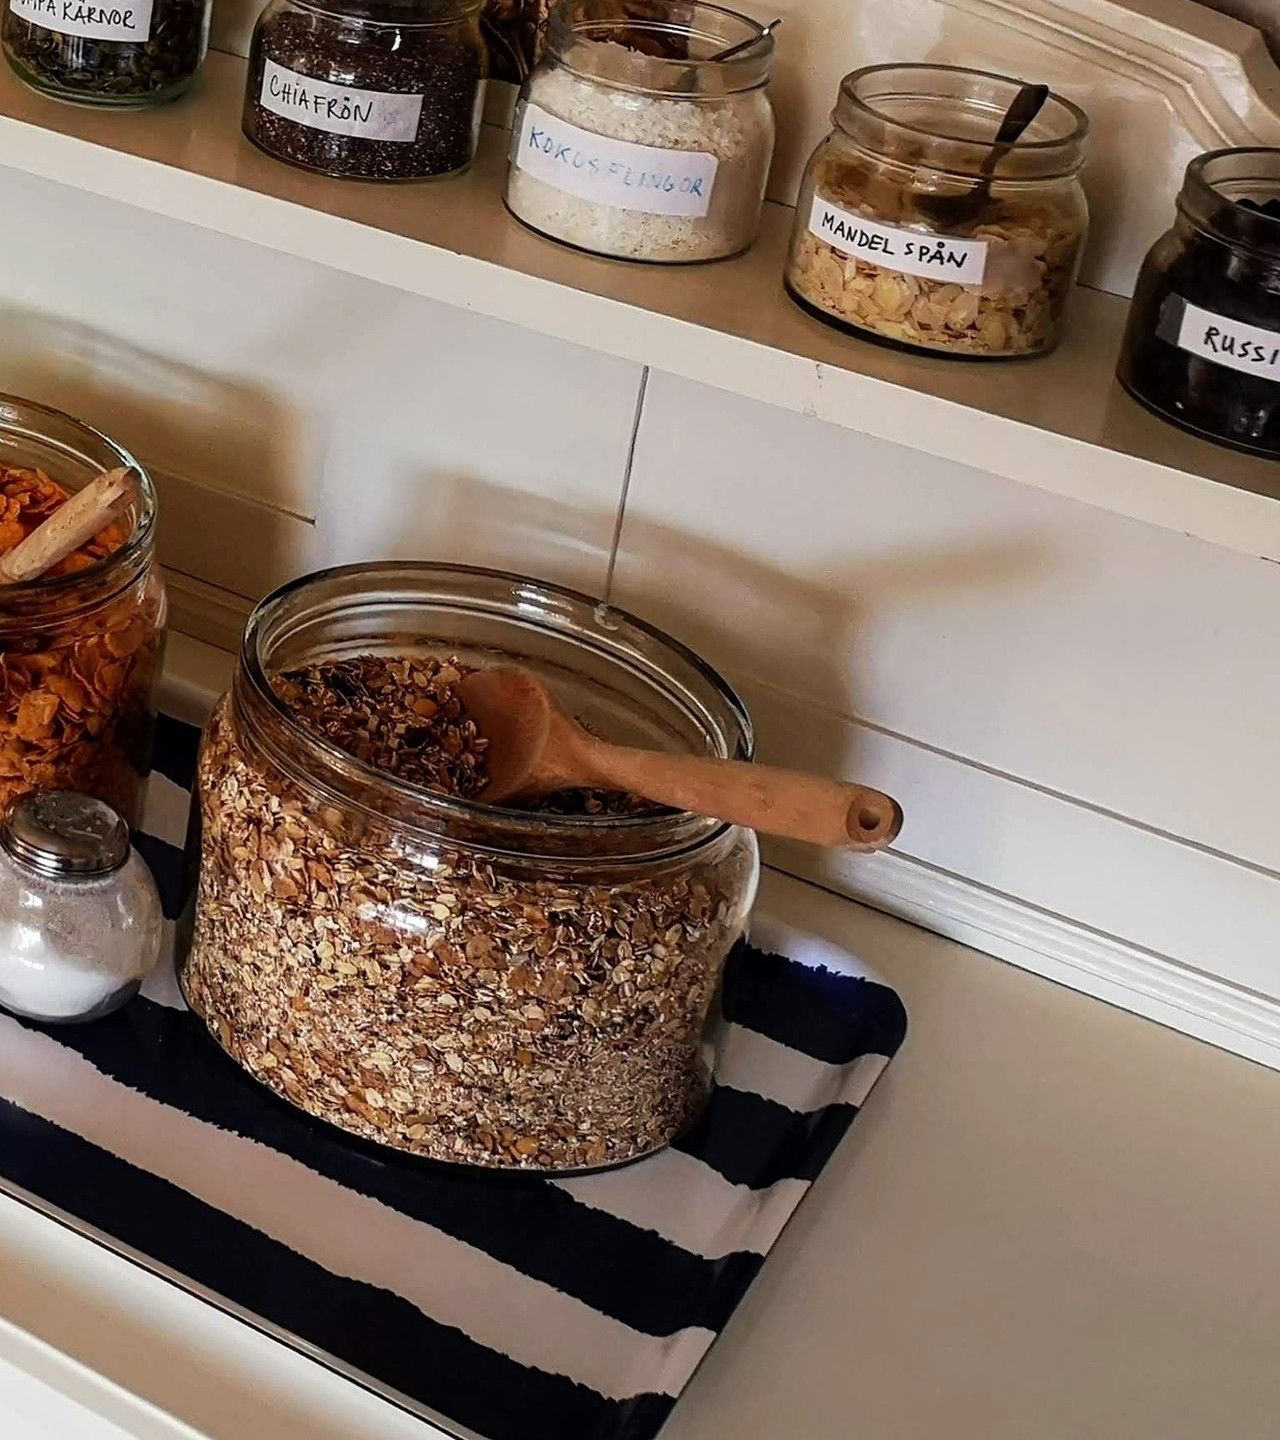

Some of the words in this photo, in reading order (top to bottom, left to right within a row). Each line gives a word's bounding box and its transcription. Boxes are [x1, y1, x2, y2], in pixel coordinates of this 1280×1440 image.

[269, 74, 373, 123] CHIAFRÖN
[822, 212, 895, 255] MANDEL
[904, 241, 968, 268] SPÅN
[1204, 325, 1280, 365] RUSSI
